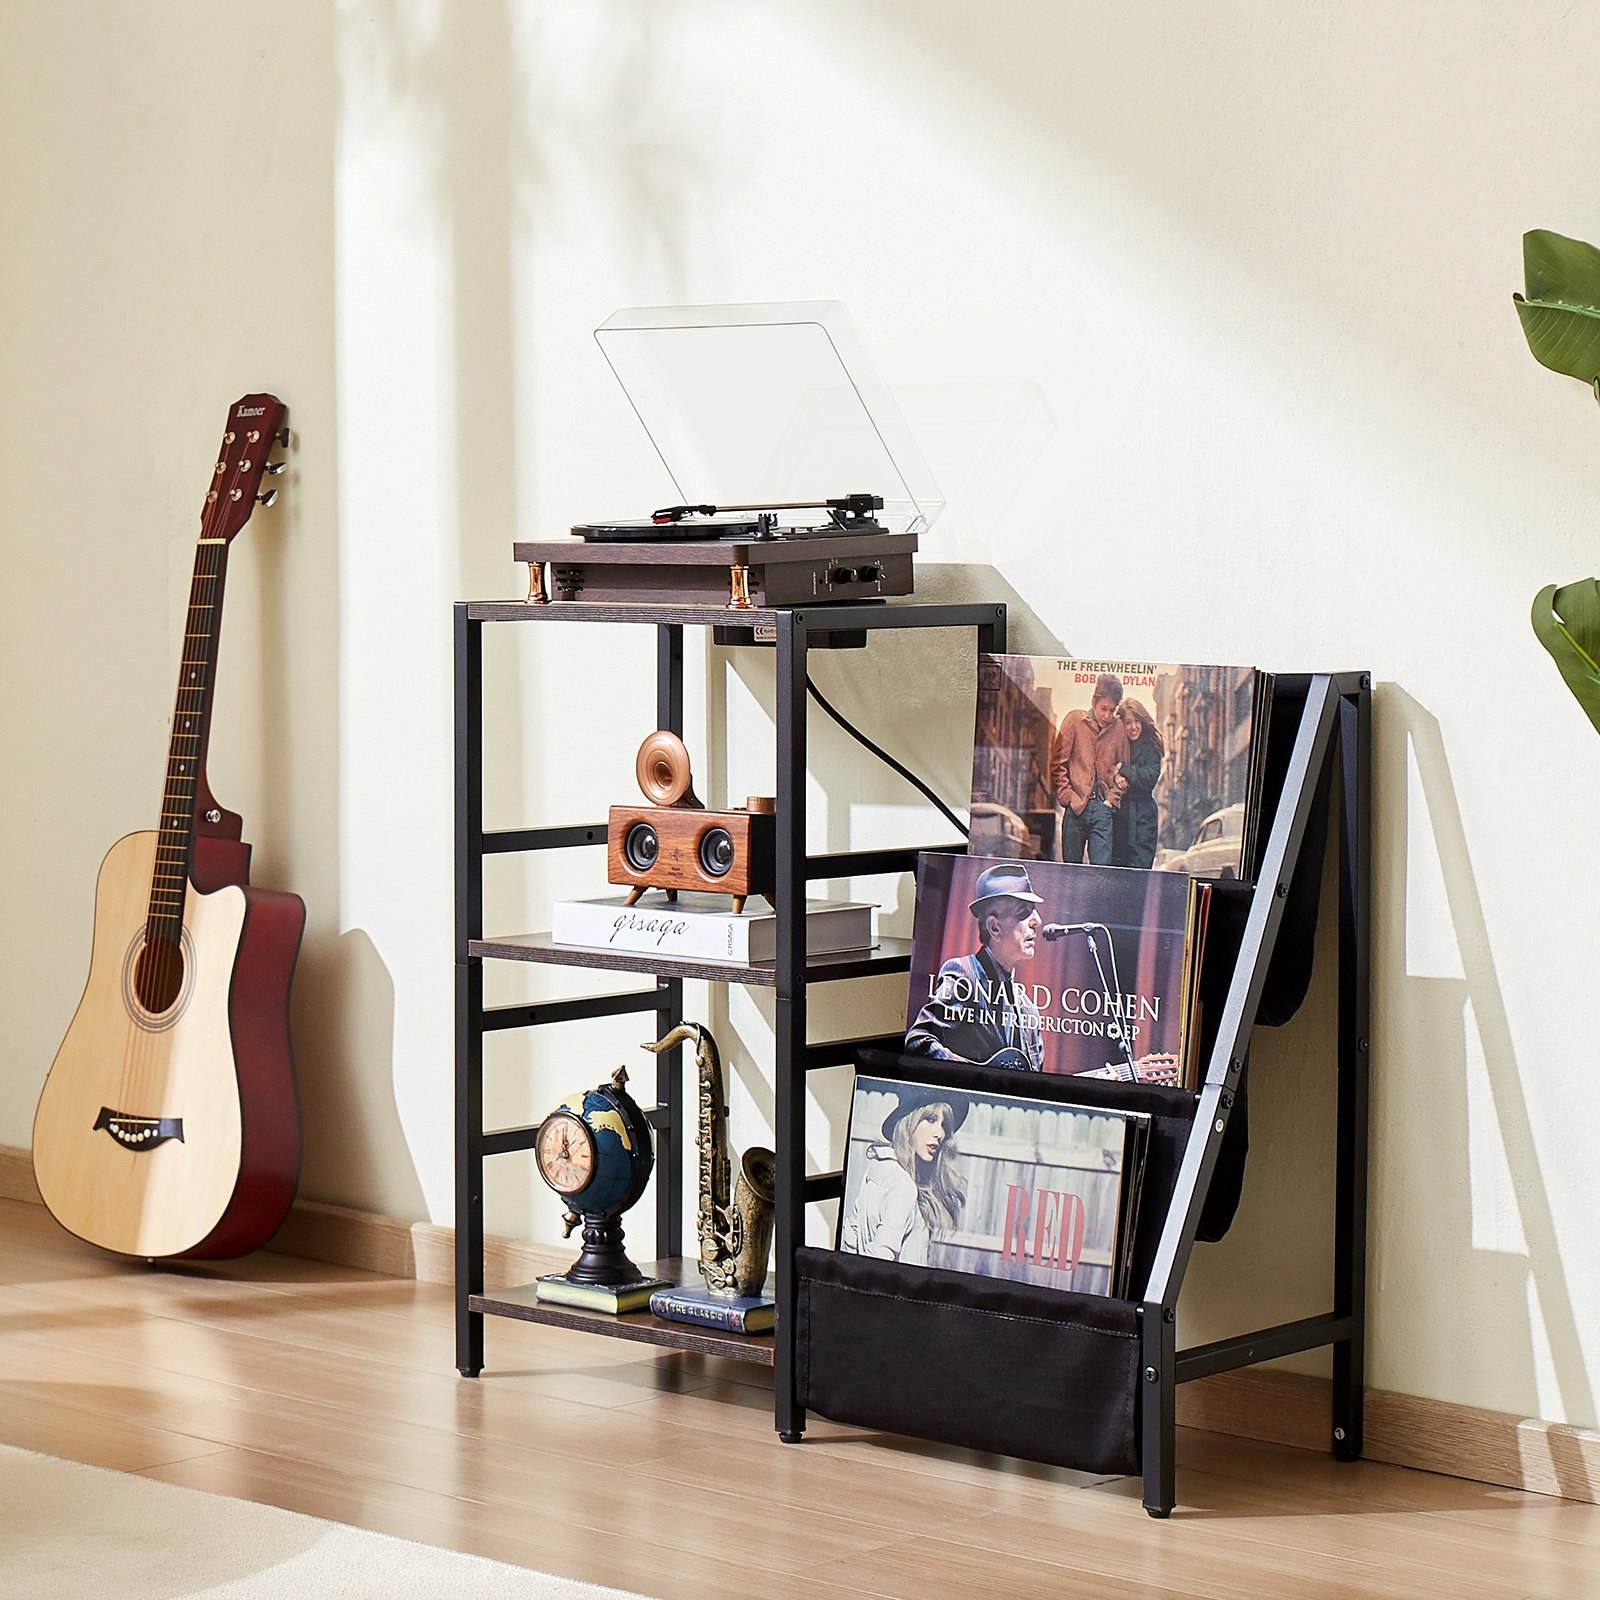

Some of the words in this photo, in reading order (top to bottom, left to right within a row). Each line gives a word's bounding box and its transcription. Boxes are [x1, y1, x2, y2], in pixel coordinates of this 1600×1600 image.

[1057, 660, 1077, 671] THE
[1080, 661, 1157, 675] FREEWHEELIN'
[1074, 673, 1097, 684] BOB
[1122, 675, 1156, 687] DYLAN
[927, 973, 1051, 1010] LEONARD
[1061, 987, 1161, 1022] COHEN
[943, 1005, 975, 1024] LIVE
[979, 1010, 996, 1026] IN
[1001, 1012, 1104, 1038] FREDERICTON
[1124, 1026, 1140, 1041] EP
[999, 1184, 1085, 1272] RED
[670, 1303, 686, 1315] THE
